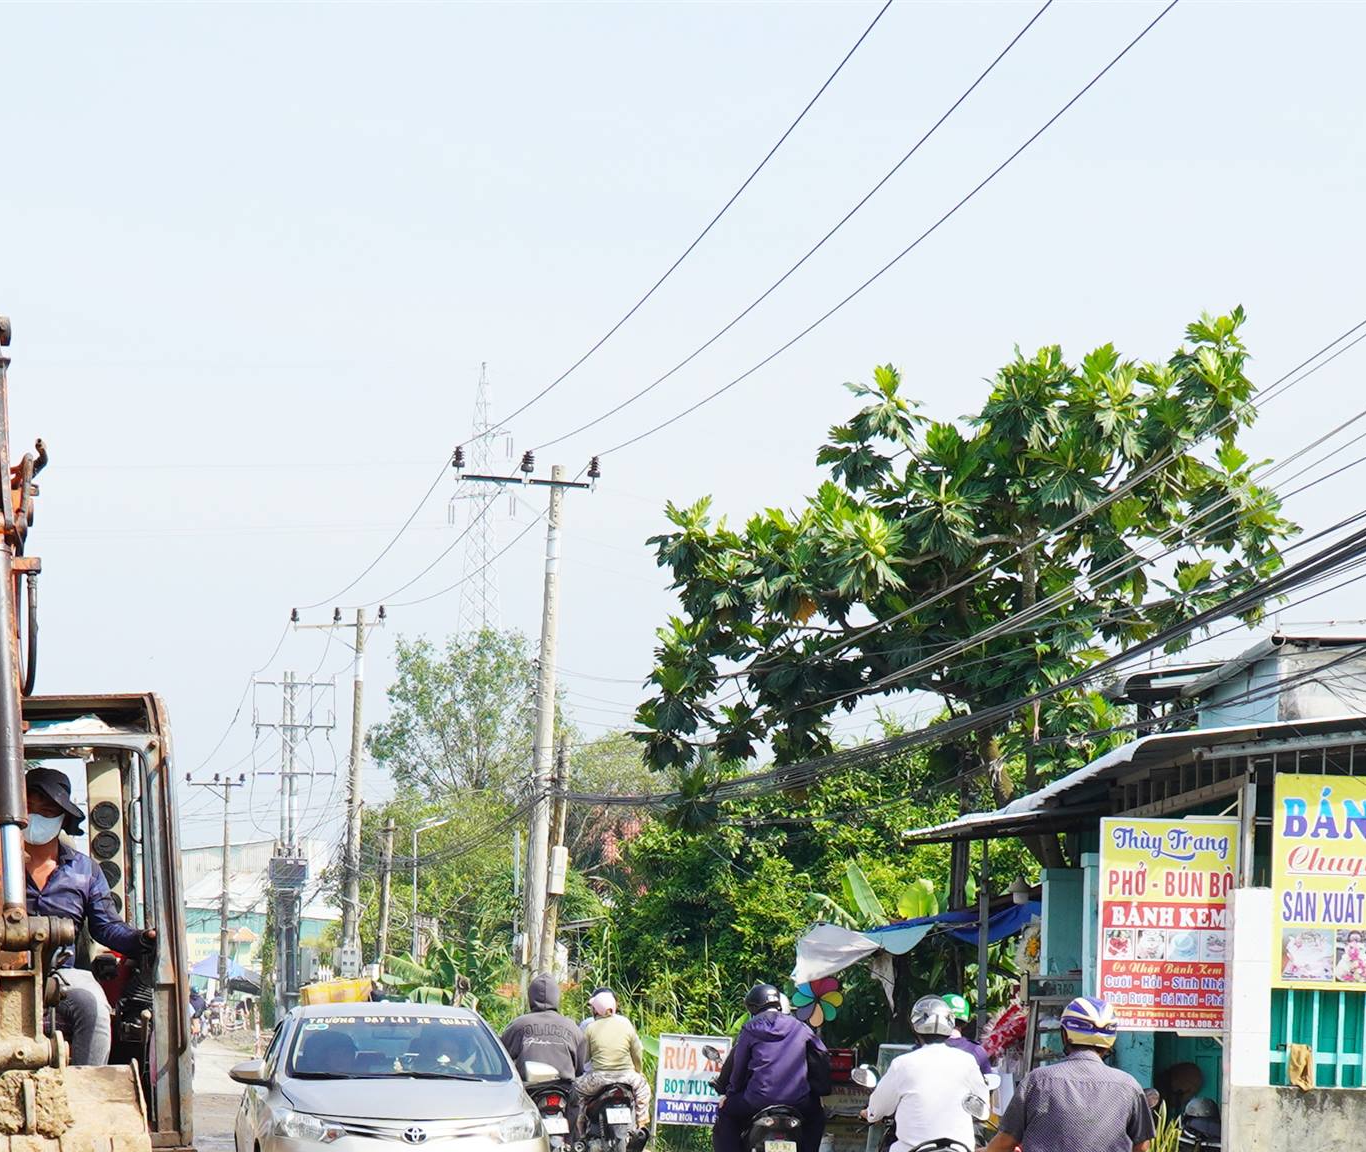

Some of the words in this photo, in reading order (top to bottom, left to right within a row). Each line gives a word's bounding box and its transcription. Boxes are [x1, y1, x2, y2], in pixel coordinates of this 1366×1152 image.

[1113, 827, 1164, 859] Thùy
[1167, 829, 1229, 859] Trang
[1108, 861, 1147, 896] PHỞ
[1165, 866, 1203, 897] BÚN
[1209, 866, 1234, 897] BÒ
[1282, 881, 1316, 922] SẢN
[1322, 882, 1365, 924] XUẤT
[1111, 902, 1174, 927] BÁNH
[1180, 907, 1228, 928] KEM
[1197, 963, 1222, 975] Kem
[1172, 976, 1199, 990] Sinh
[1201, 977, 1225, 991] Nhậ
[1205, 994, 1224, 1006] Phá
[688, 1074, 721, 1097] TUYẾ
[666, 1102, 690, 1111] THAY
